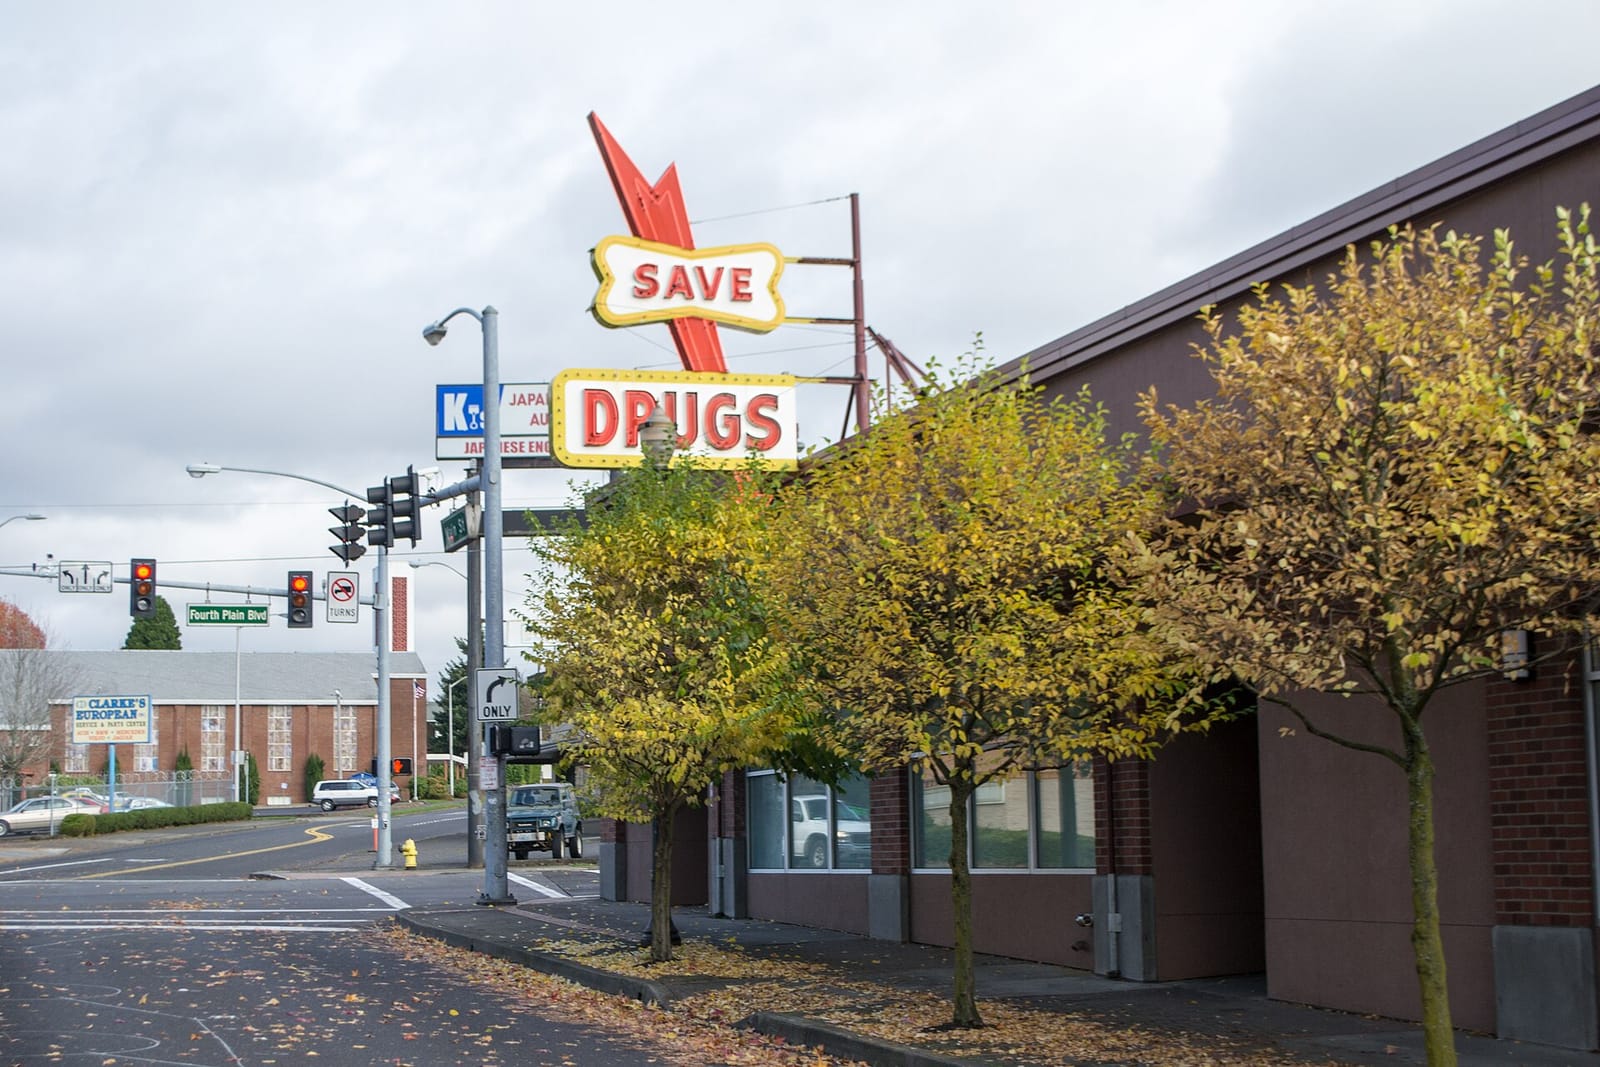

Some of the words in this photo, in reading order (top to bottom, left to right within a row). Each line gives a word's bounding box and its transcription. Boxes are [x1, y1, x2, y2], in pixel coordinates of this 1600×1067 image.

[633, 263, 753, 302] SAVE
[509, 393, 550, 407] JAPA
[190, 608, 220, 620] Fourth
[222, 609, 245, 620] Plain
[247, 609, 267, 620] Blvd
[330, 607, 356, 617] TURNS
[89, 698, 146, 709] CLARKE'S
[76, 709, 138, 720] EUROPEAN
[483, 705, 512, 718] ONLY
